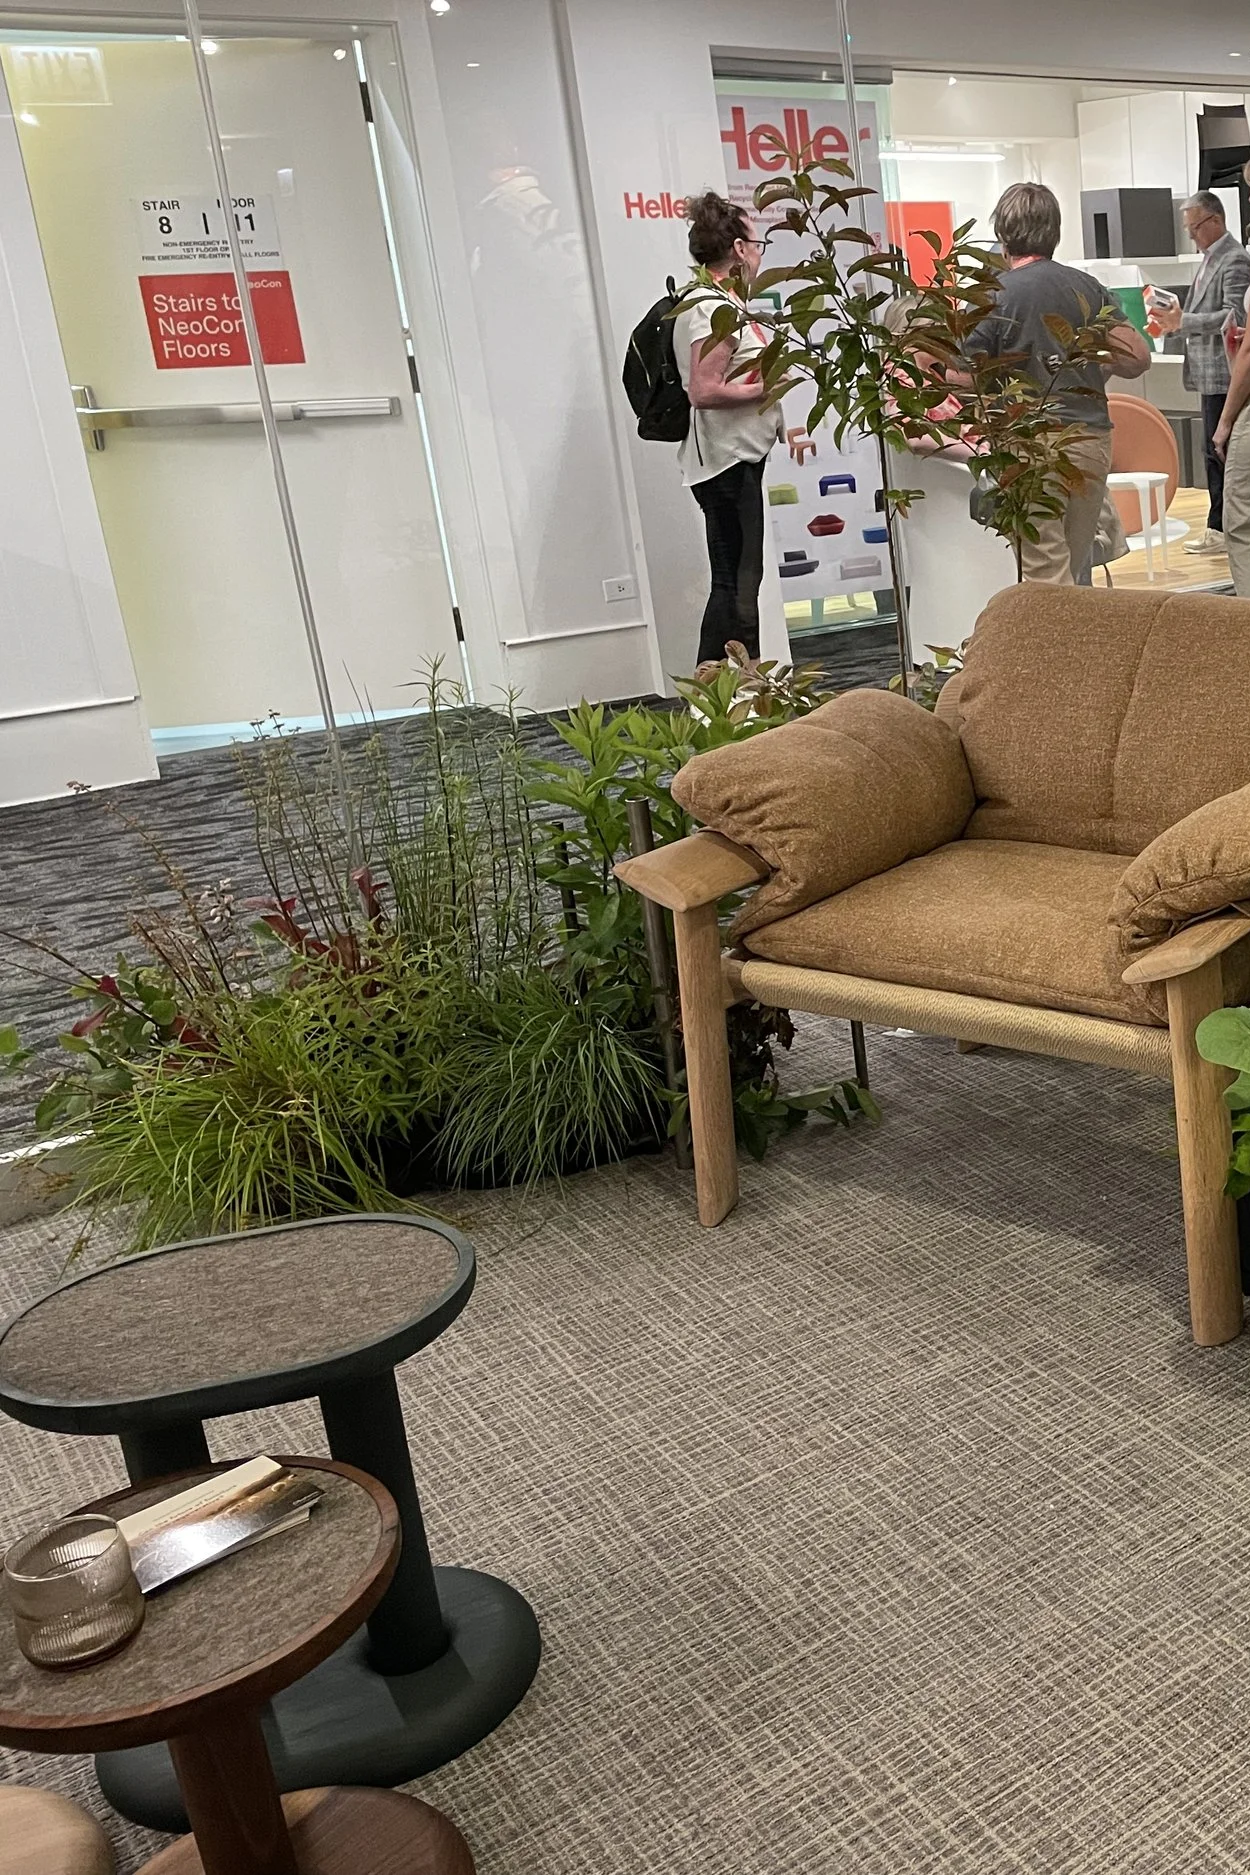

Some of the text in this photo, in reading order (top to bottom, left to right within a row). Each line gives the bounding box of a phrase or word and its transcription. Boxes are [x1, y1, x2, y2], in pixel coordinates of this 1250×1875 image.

[142, 200, 180, 211] STAIR
[623, 192, 687, 219] Helle
[158, 216, 172, 234] 8
[248, 279, 282, 289] eoCon
[153, 293, 242, 313] Stairs to
[163, 339, 231, 359] Floors
